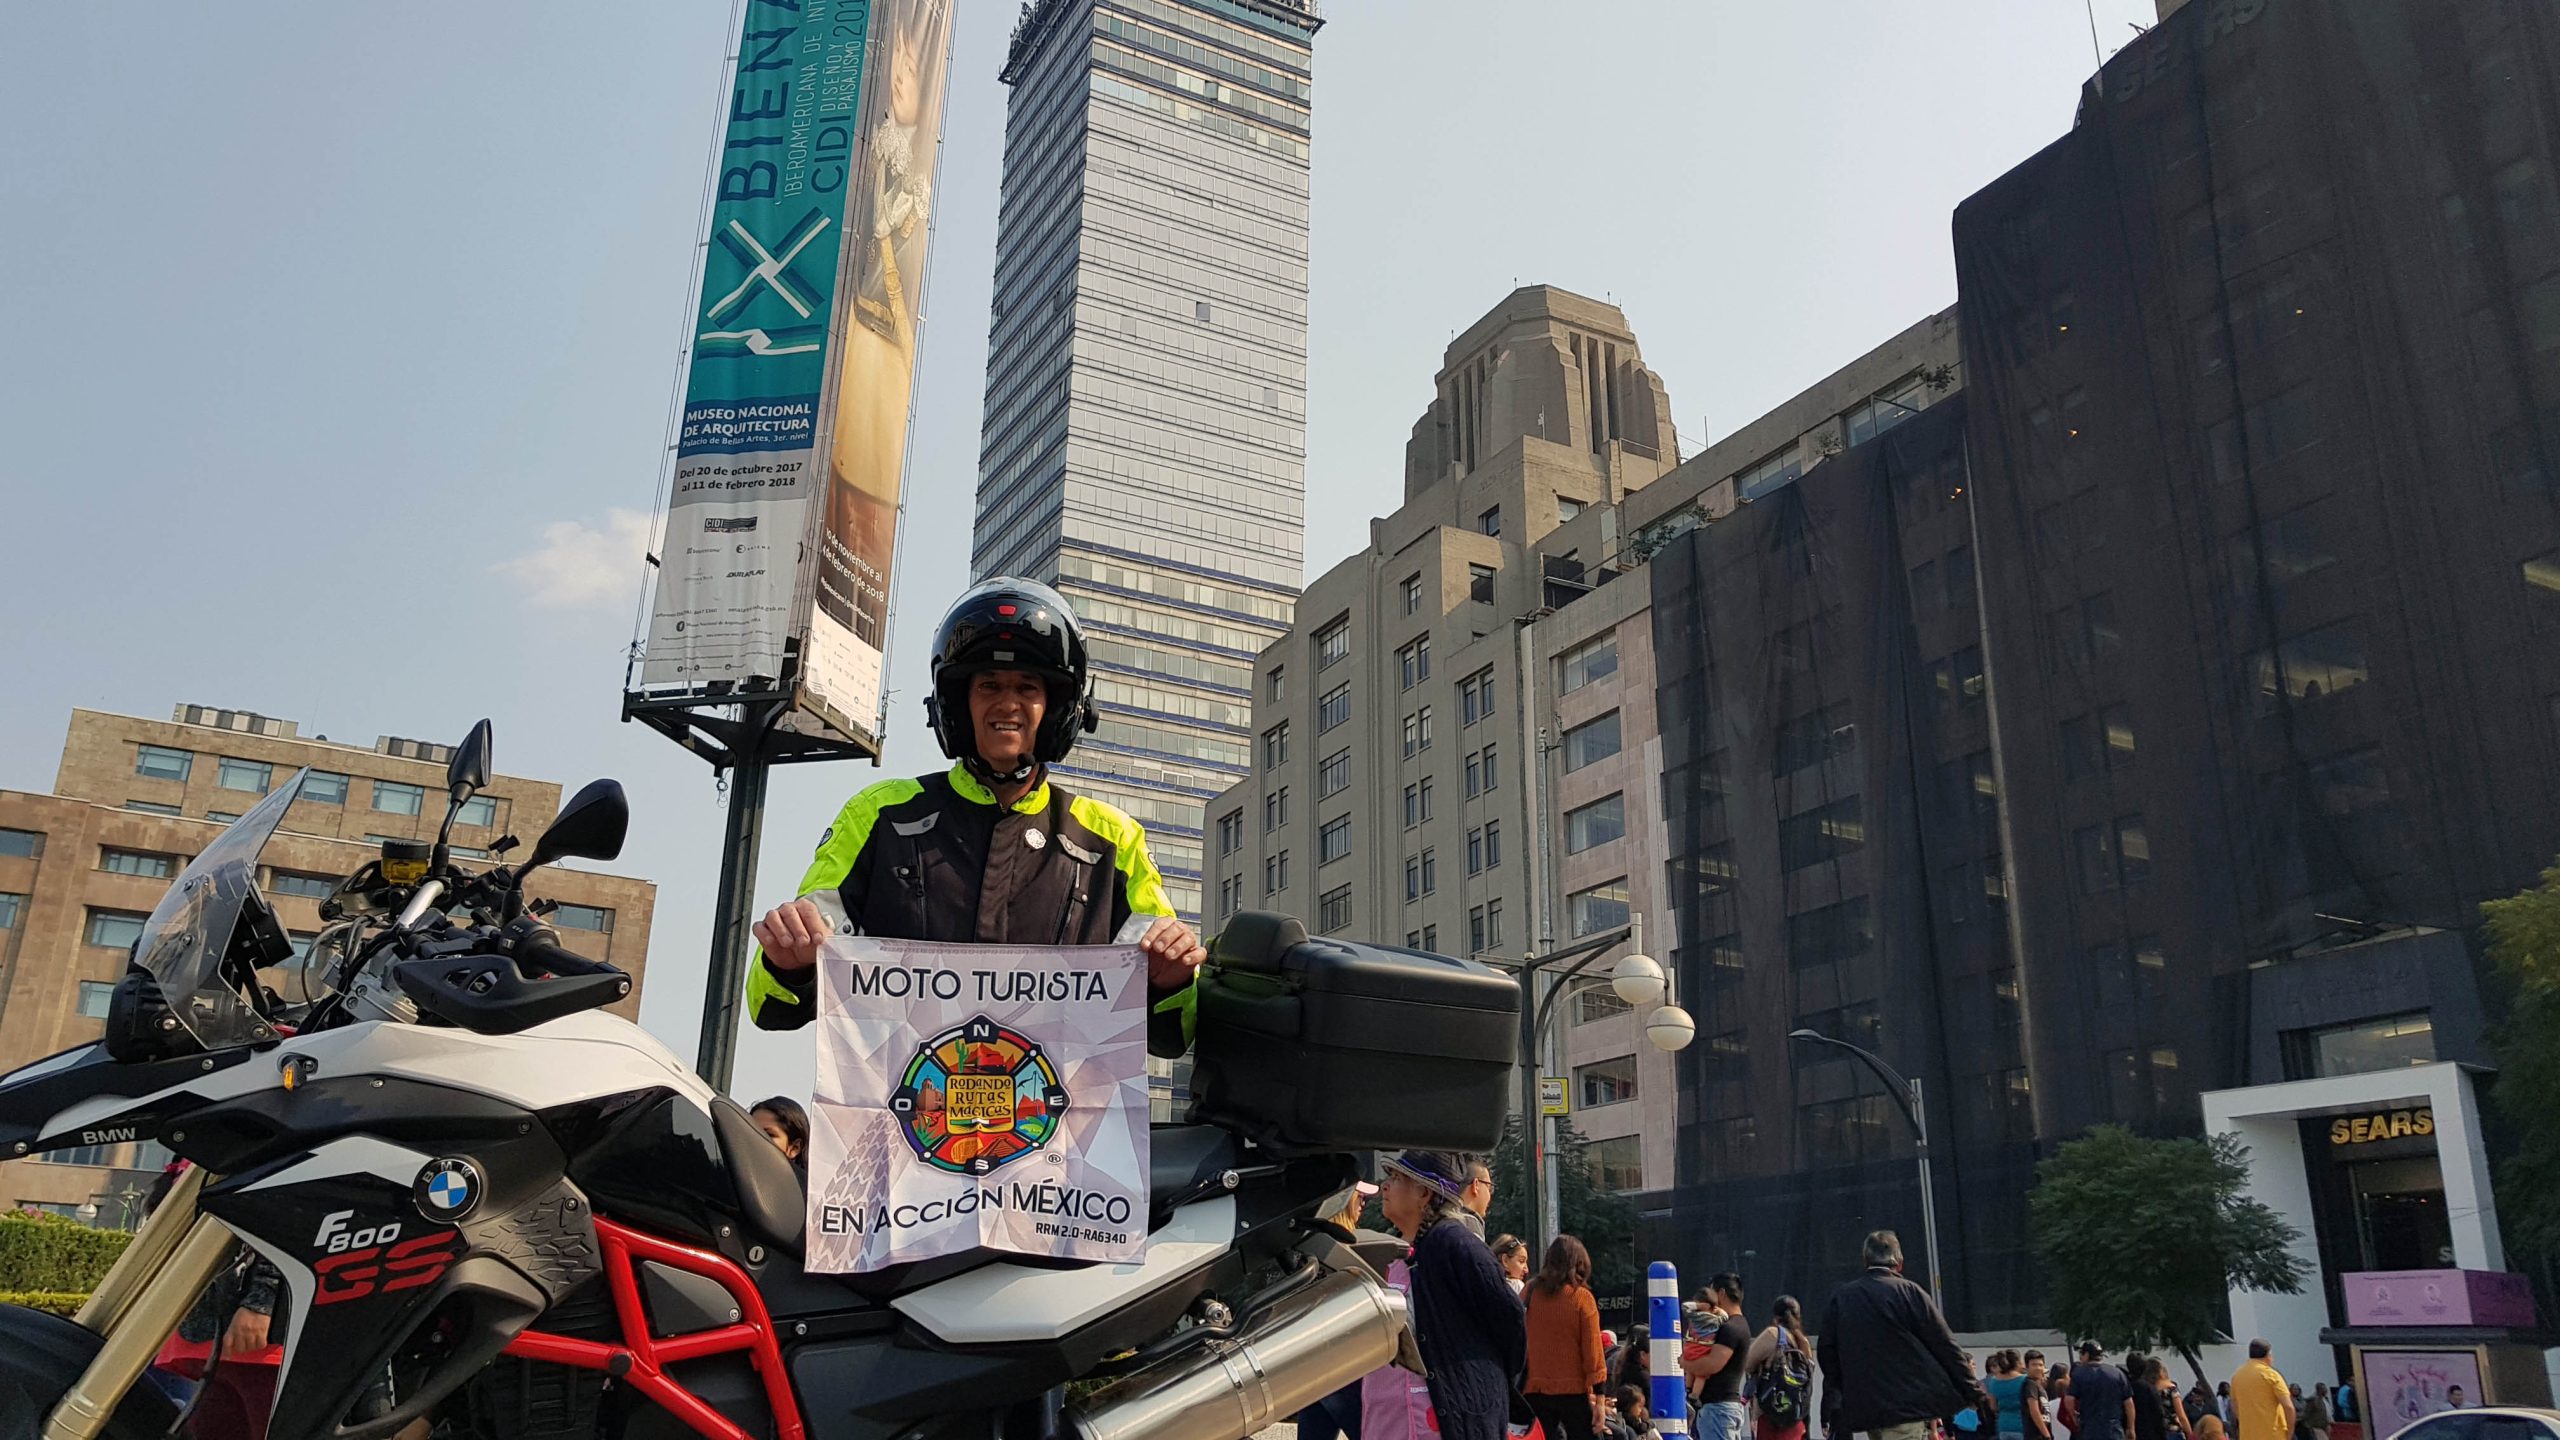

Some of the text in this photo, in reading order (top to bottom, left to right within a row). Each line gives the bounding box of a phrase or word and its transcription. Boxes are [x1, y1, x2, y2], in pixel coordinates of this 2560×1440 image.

[837, 40, 862, 110] PAISAJISMO
[719, 0, 802, 202] BIEN
[783, 62, 819, 199] IBEROAMERICANA
[803, 32, 823, 54] DE
[810, 115, 851, 194] CIDI
[686, 403, 811, 423] MUSEO NACIONAL
[684, 418, 810, 438] DE ARQUITECTURA
[682, 437, 707, 448] Palacio
[709, 437, 720, 445] de
[790, 431, 808, 440] nivel
[680, 461, 803, 479] Del 20 de octubre 2017
[681, 476, 796, 492] al 11 de febrero 2018
[838, 543, 875, 578] noviembre
[875, 570, 883, 583] al
[831, 553, 856, 582] febrero
[856, 575, 866, 590] de
[866, 584, 885, 602] 2018
[851, 963, 1109, 1002] MOTO TURISTA
[973, 1024, 990, 1037] N
[895, 1098, 912, 1111] O
[1049, 1095, 1063, 1108] E
[82, 1127, 137, 1145] BMW
[2330, 1108, 2435, 1146] SEARS
[421, 1160, 473, 1183] BMW
[975, 1159, 989, 1171] S
[822, 1177, 1131, 1234] EN ACCIÓN MÉXICO
[313, 1230, 458, 1305] GS
[1598, 1295, 1632, 1310] SEARS
